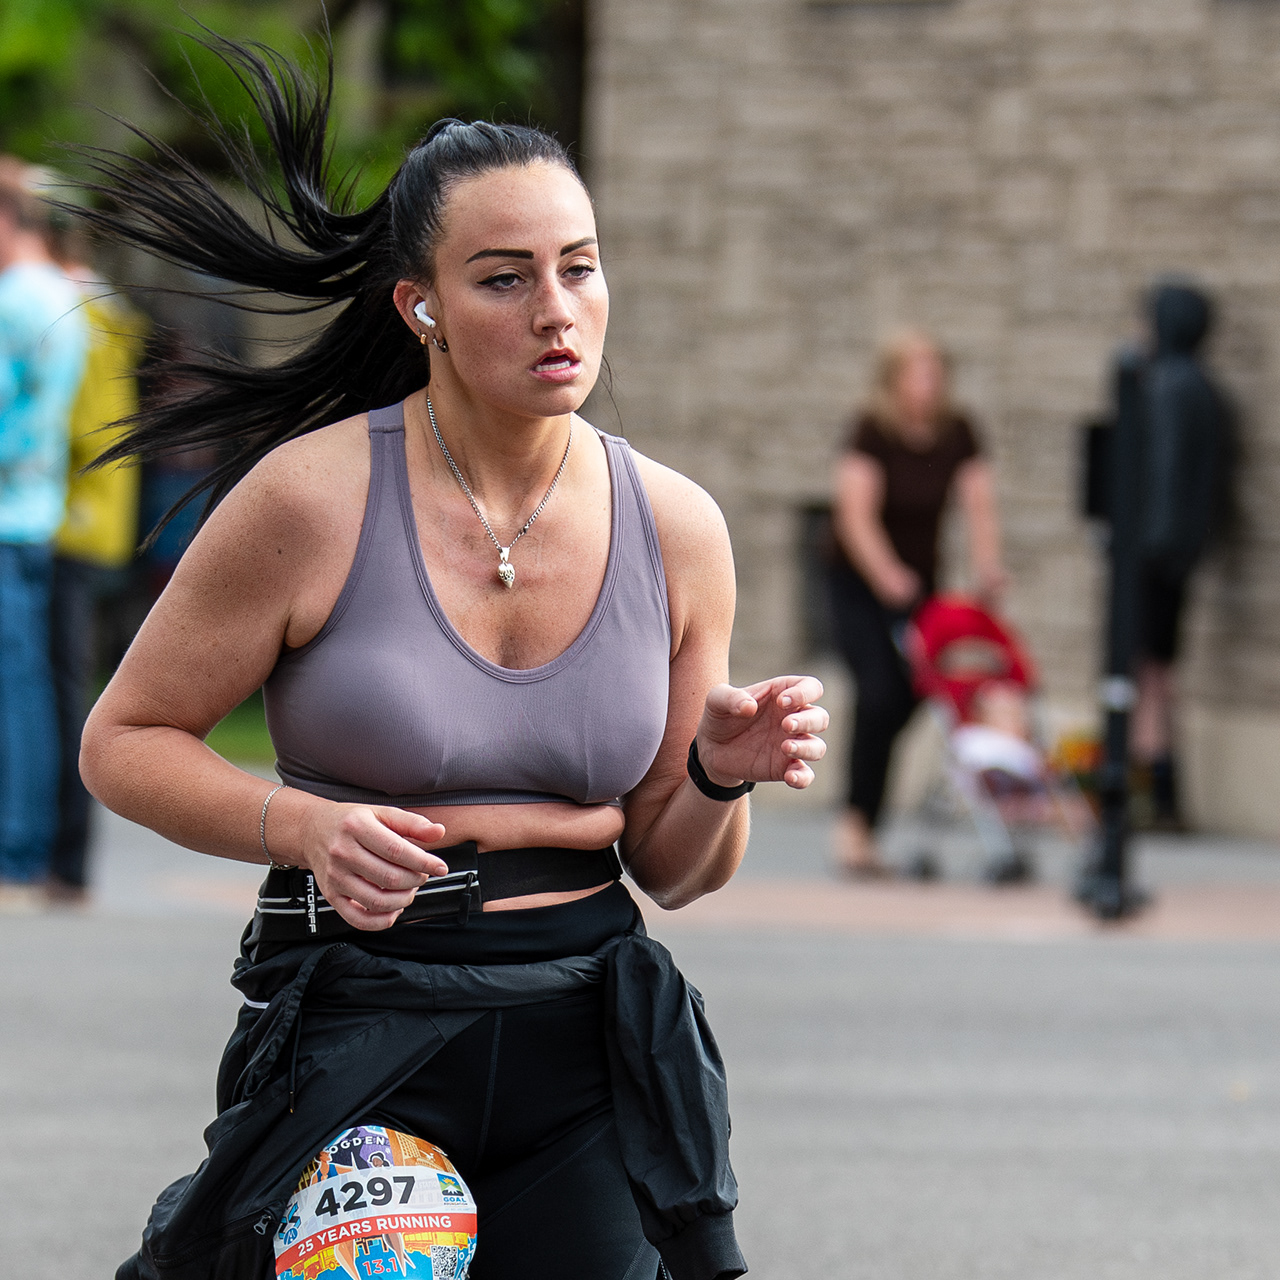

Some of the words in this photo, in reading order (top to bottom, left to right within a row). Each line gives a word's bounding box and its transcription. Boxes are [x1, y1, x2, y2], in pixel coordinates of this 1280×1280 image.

[306, 874, 317, 933] FITGRIFF
[330, 1136, 386, 1154] OGDEN
[315, 1176, 416, 1217] 4297
[297, 1239, 314, 1257] 25
[317, 1220, 372, 1244] YEARS
[379, 1215, 452, 1235] RUNNING
[363, 1257, 399, 1276] 13.1
